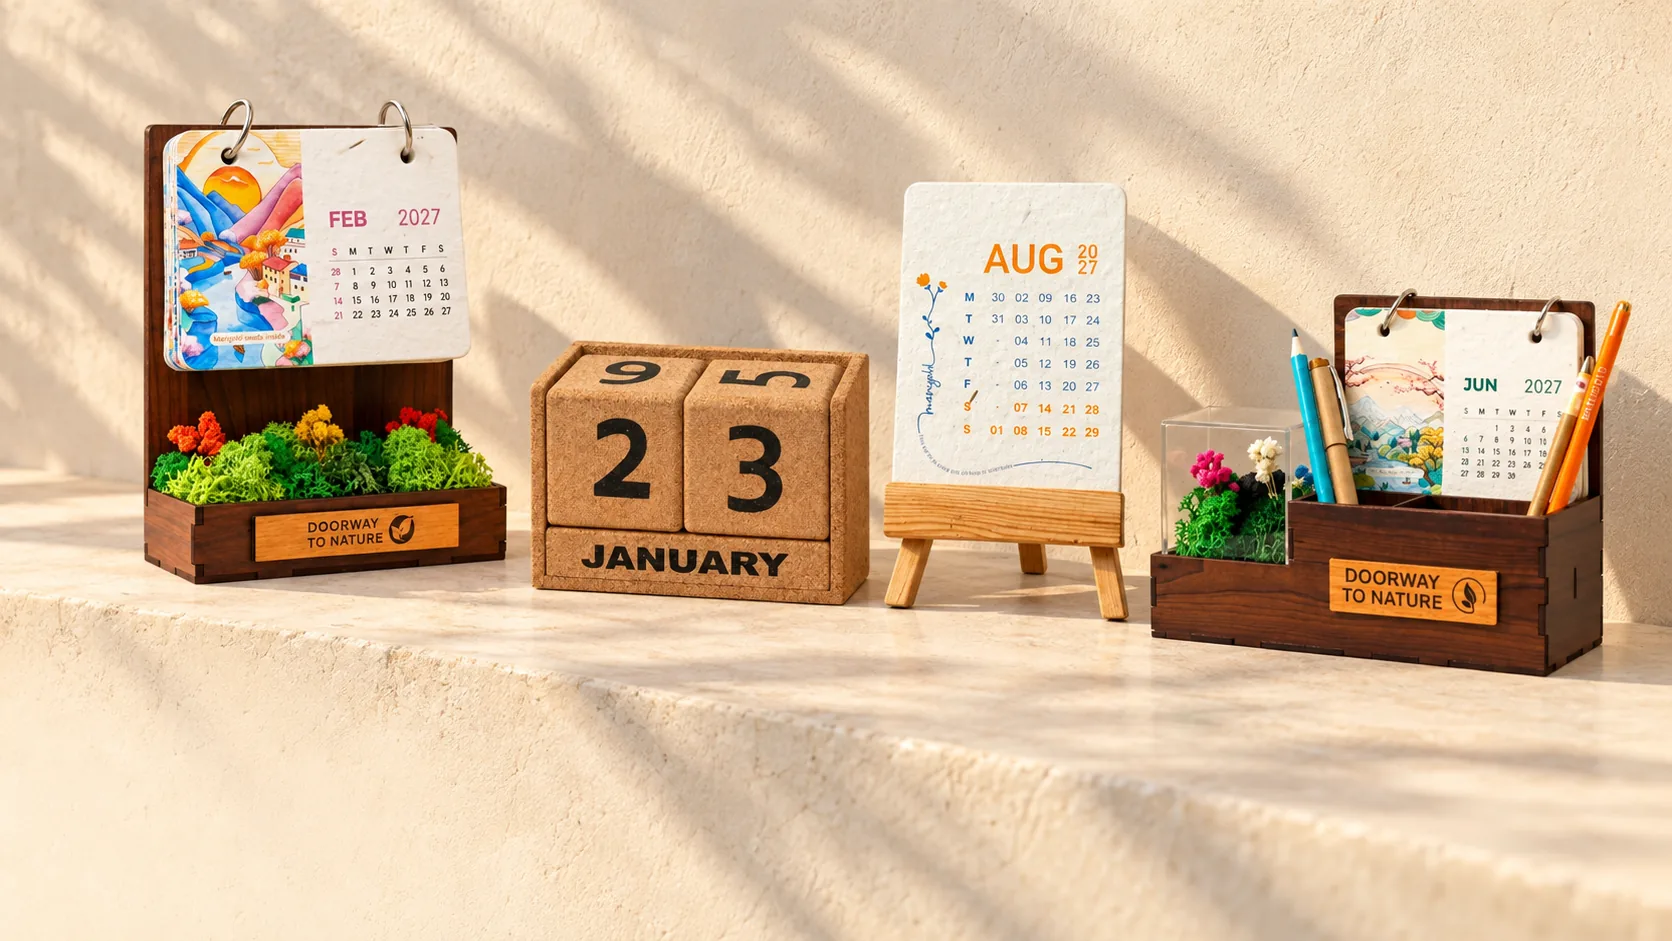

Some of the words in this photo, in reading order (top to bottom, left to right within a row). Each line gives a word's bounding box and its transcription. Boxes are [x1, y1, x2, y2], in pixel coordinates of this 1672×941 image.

[330, 211, 367, 227] FEB
[399, 208, 440, 226] 2027
[332, 248, 337, 256] S
[1078, 244, 1098, 259] 20
[984, 244, 1063, 274] AUG
[331, 268, 341, 276] 28
[370, 267, 375, 275] 2
[423, 265, 428, 273] 5
[1078, 260, 1098, 274] 27
[353, 282, 358, 290] 8
[371, 281, 376, 289] 9
[405, 280, 412, 288] 11
[423, 279, 431, 287] 12
[353, 296, 361, 304] 15
[406, 294, 414, 302] 18
[424, 293, 432, 301] 19
[441, 292, 450, 300] 20
[965, 293, 974, 301] M
[992, 293, 1005, 302] 30
[1015, 293, 1028, 302] 02
[1039, 293, 1052, 302] 09
[1065, 294, 1076, 302] 16
[1087, 294, 1100, 303] 23
[335, 311, 343, 320] 21
[353, 311, 362, 319] 22
[371, 310, 381, 318] 23
[389, 309, 398, 317] 24
[407, 308, 416, 316] 25
[442, 307, 450, 315] 27
[966, 314, 972, 323] T
[992, 314, 1003, 323] 31
[1015, 315, 1028, 324] 03
[1040, 315, 1051, 324] 10
[1064, 316, 1076, 324] 17
[1087, 316, 1099, 325] 24
[963, 336, 974, 344] W
[1015, 336, 1028, 345] 04
[1041, 337, 1050, 346] 11
[1064, 338, 1076, 347] 18
[1086, 338, 1099, 347] 25
[965, 358, 972, 366] T
[1015, 358, 1027, 367] 05
[1039, 359, 1051, 368] 12
[1064, 360, 1076, 368] 19
[1086, 360, 1099, 369] 26
[599, 361, 661, 385] 9
[719, 370, 810, 388] 5
[965, 379, 970, 388] F
[1014, 380, 1027, 390] 06
[1039, 381, 1051, 390] 13
[1063, 382, 1076, 391] 20
[1086, 382, 1099, 391] 27
[1464, 378, 1497, 391] JUN
[1525, 379, 1562, 394] 2027
[964, 402, 971, 411] S
[1014, 403, 1028, 412] 07
[1039, 404, 1052, 413] 14
[1063, 404, 1075, 414] 21
[1085, 405, 1099, 414] 28
[964, 424, 970, 434] S
[990, 425, 1002, 435] 01
[1014, 426, 1028, 436] 08
[1038, 426, 1051, 436] 15
[1062, 427, 1076, 437] 22
[1085, 427, 1099, 437] 29
[594, 418, 650, 499] 2
[728, 425, 782, 513] 3
[1508, 460, 1515, 468] 23
[308, 518, 379, 533] DOORWAY
[308, 537, 325, 548] TO
[331, 533, 382, 546] NATURE
[582, 545, 788, 576] JANUARY
[1345, 568, 1440, 589] DOORWAY
[1342, 588, 1365, 603] TO
[1372, 590, 1442, 610] NATURE
